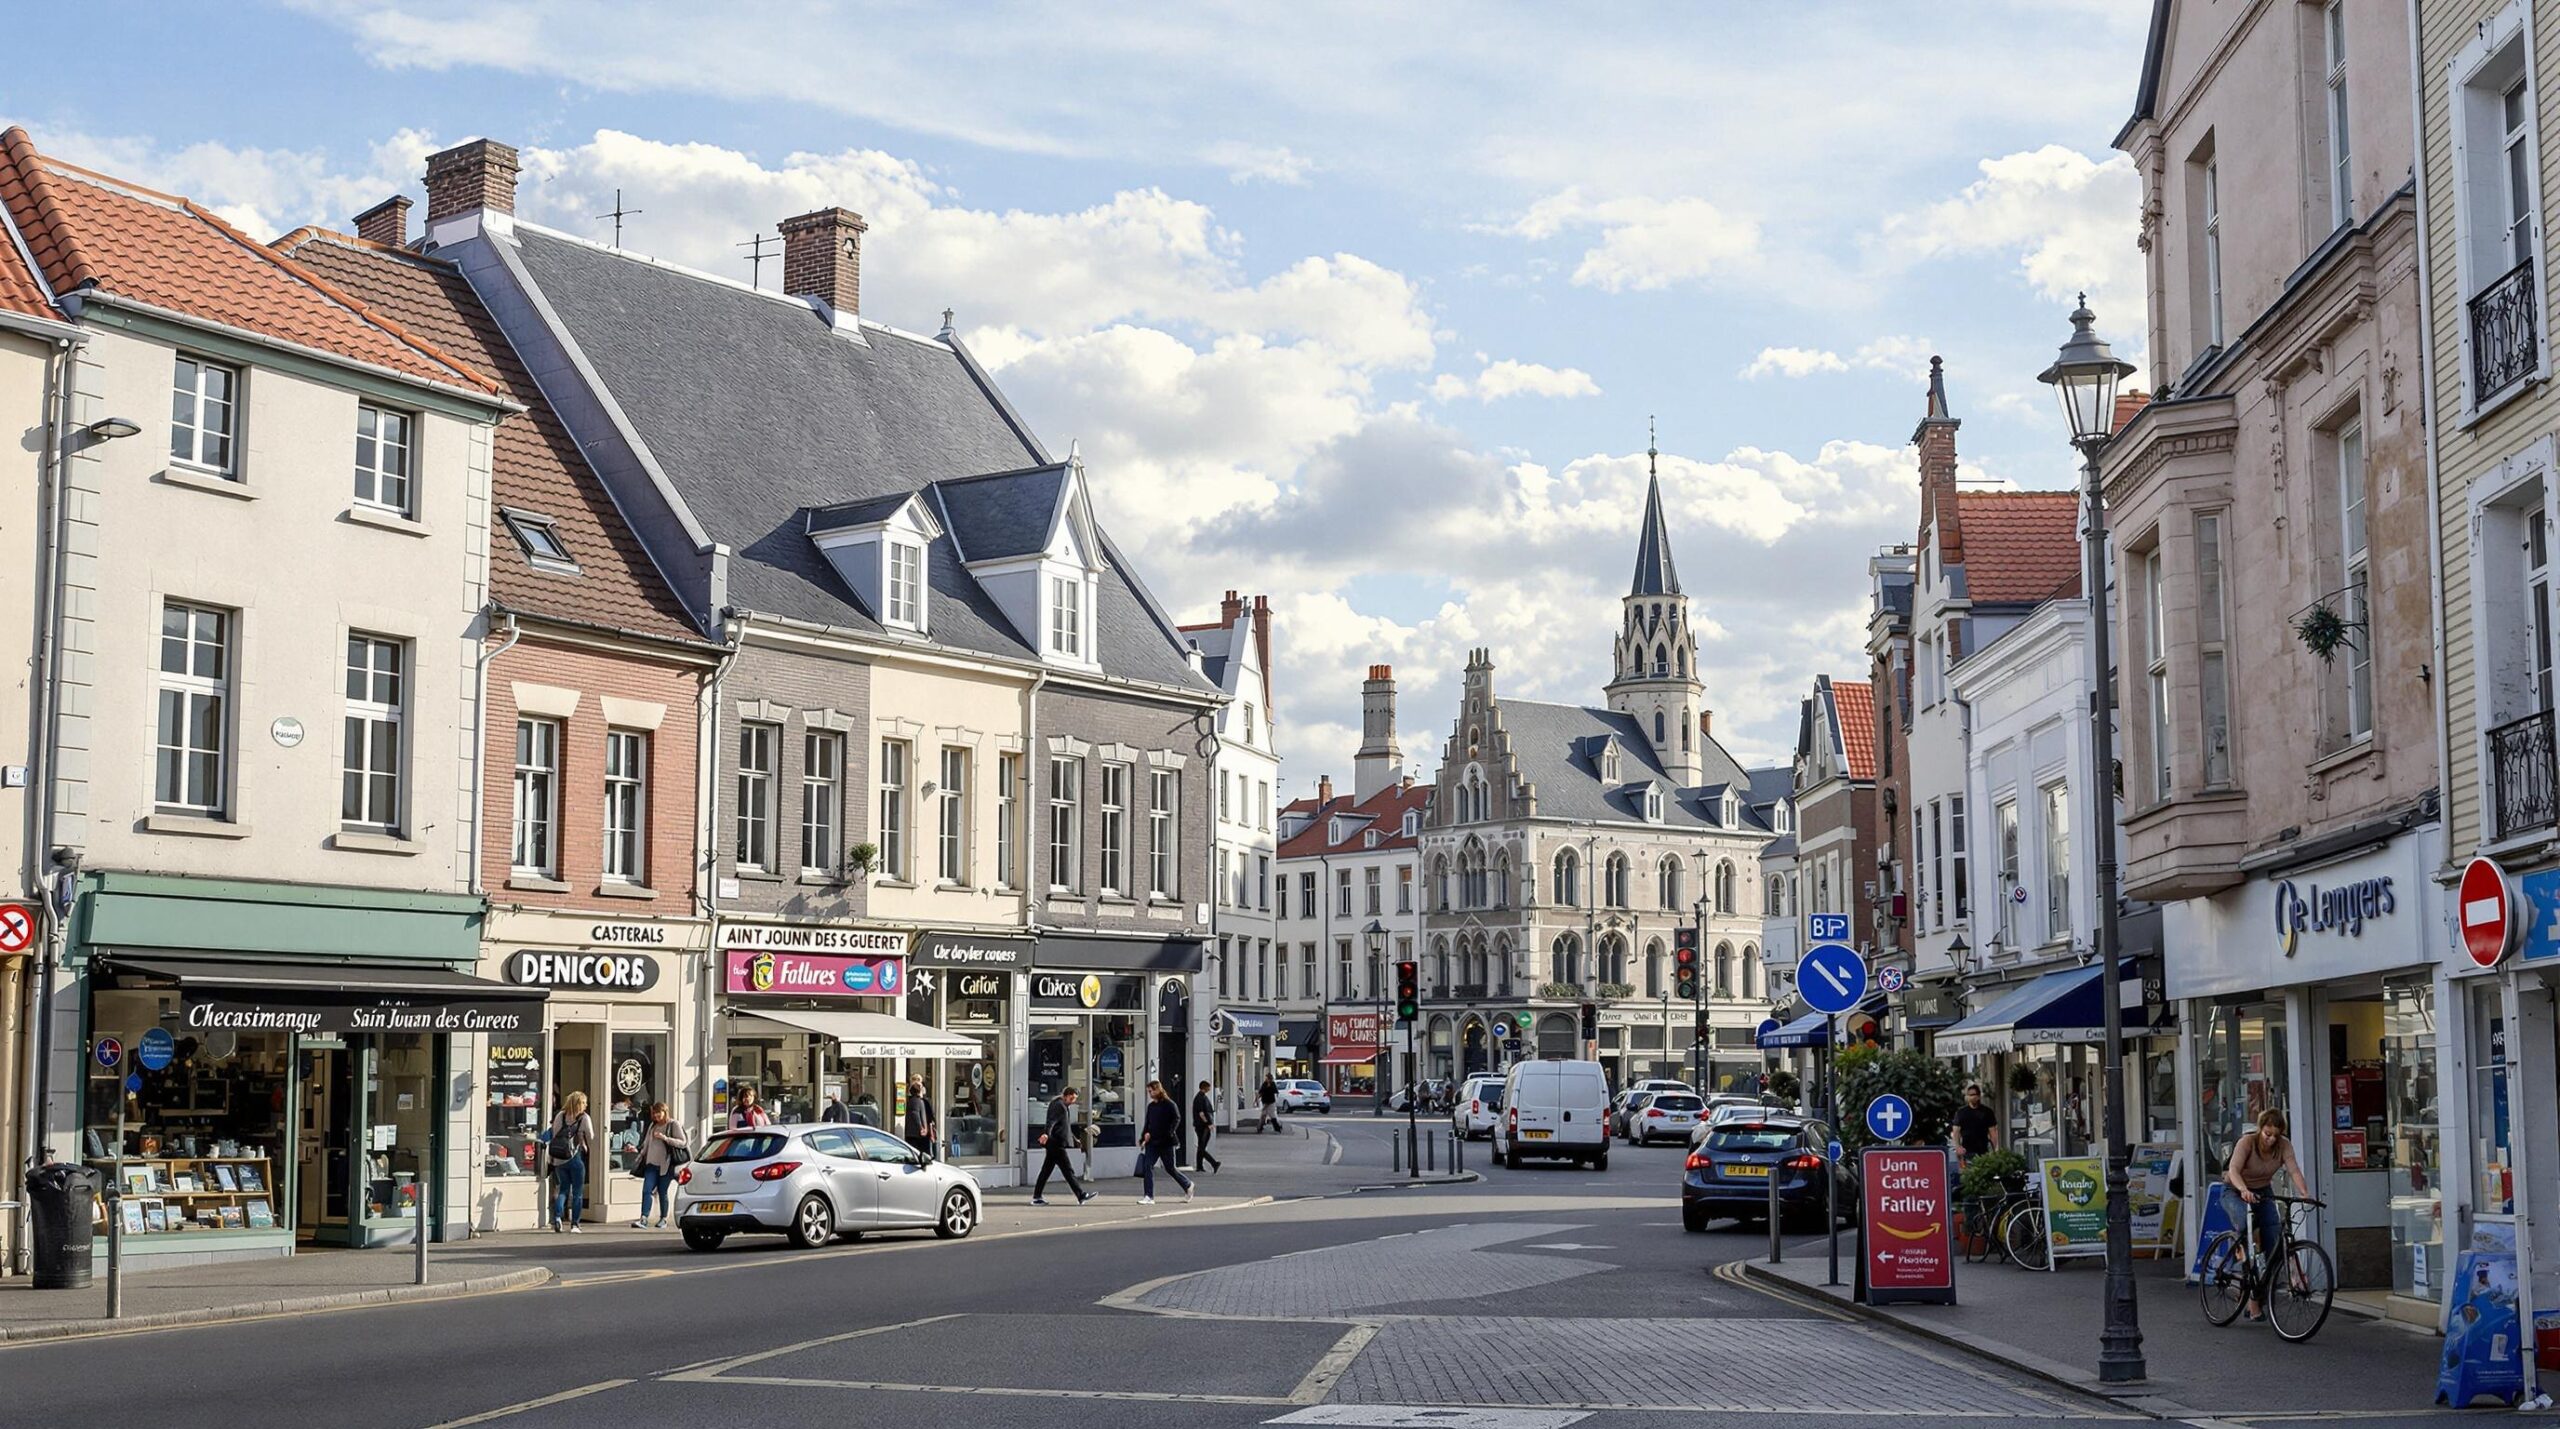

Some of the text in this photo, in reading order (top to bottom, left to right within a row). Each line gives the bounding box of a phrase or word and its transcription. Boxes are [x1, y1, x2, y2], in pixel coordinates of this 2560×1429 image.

[592, 925, 664, 943] CASTERALS
[815, 932, 837, 948] DES
[435, 1007, 460, 1029] des
